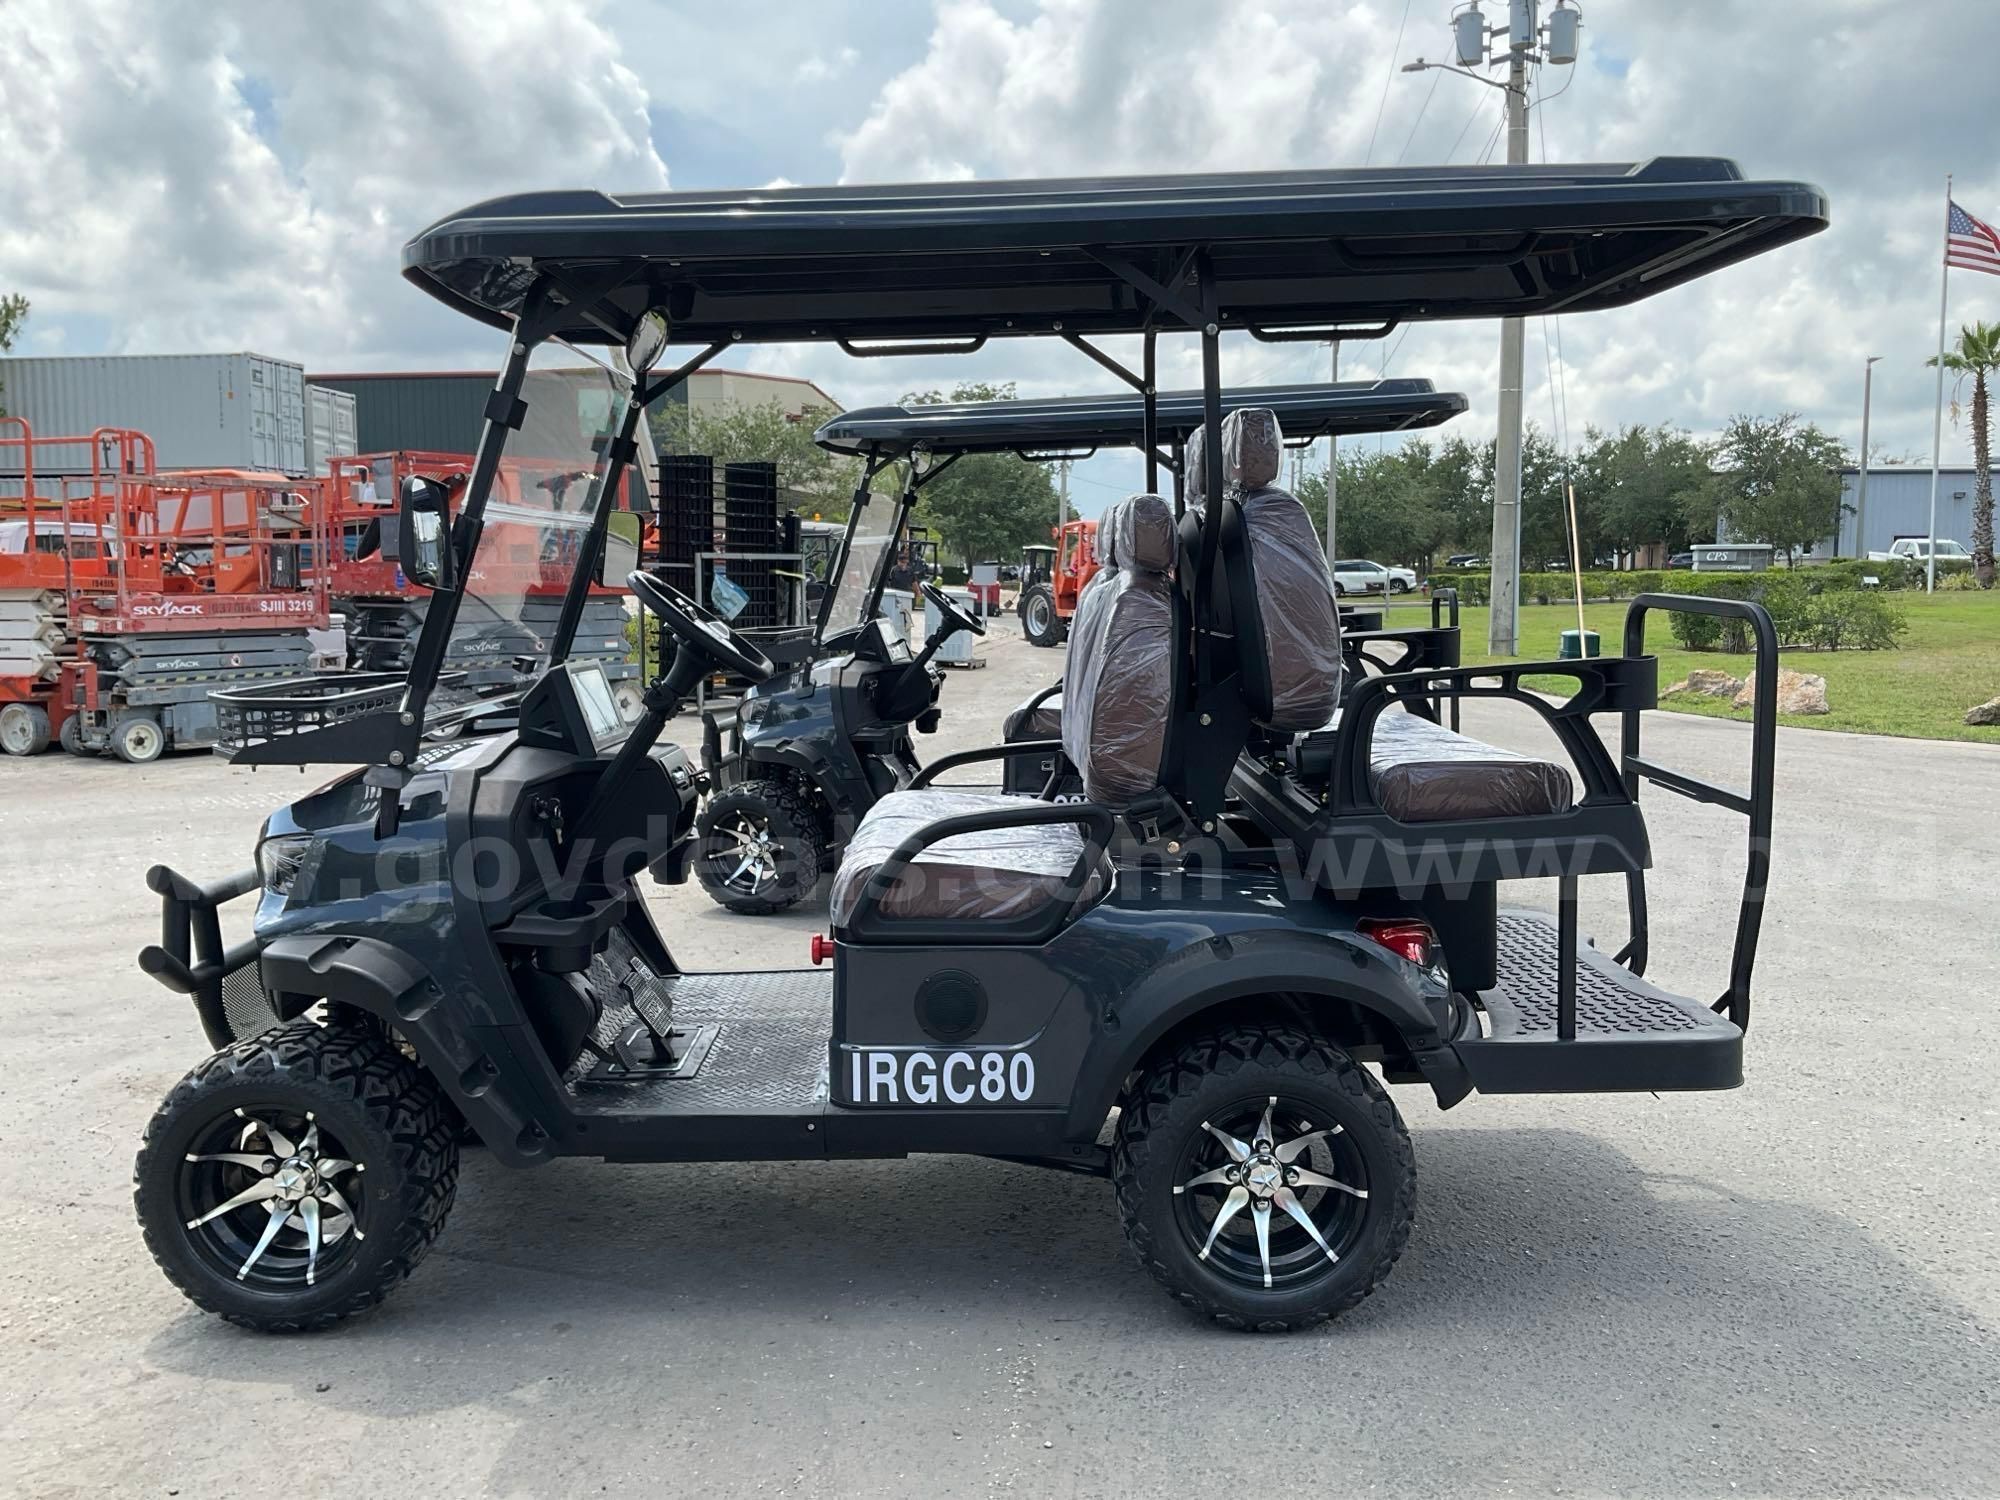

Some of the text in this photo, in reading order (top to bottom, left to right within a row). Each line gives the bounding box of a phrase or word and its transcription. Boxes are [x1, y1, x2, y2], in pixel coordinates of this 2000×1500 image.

[1706, 551, 1729, 561] CPS
[133, 601, 204, 616] SKYJACK
[288, 600, 314, 612] 3219
[156, 659, 200, 669] SKYJACK
[852, 1052, 1035, 1103] IRGC80
